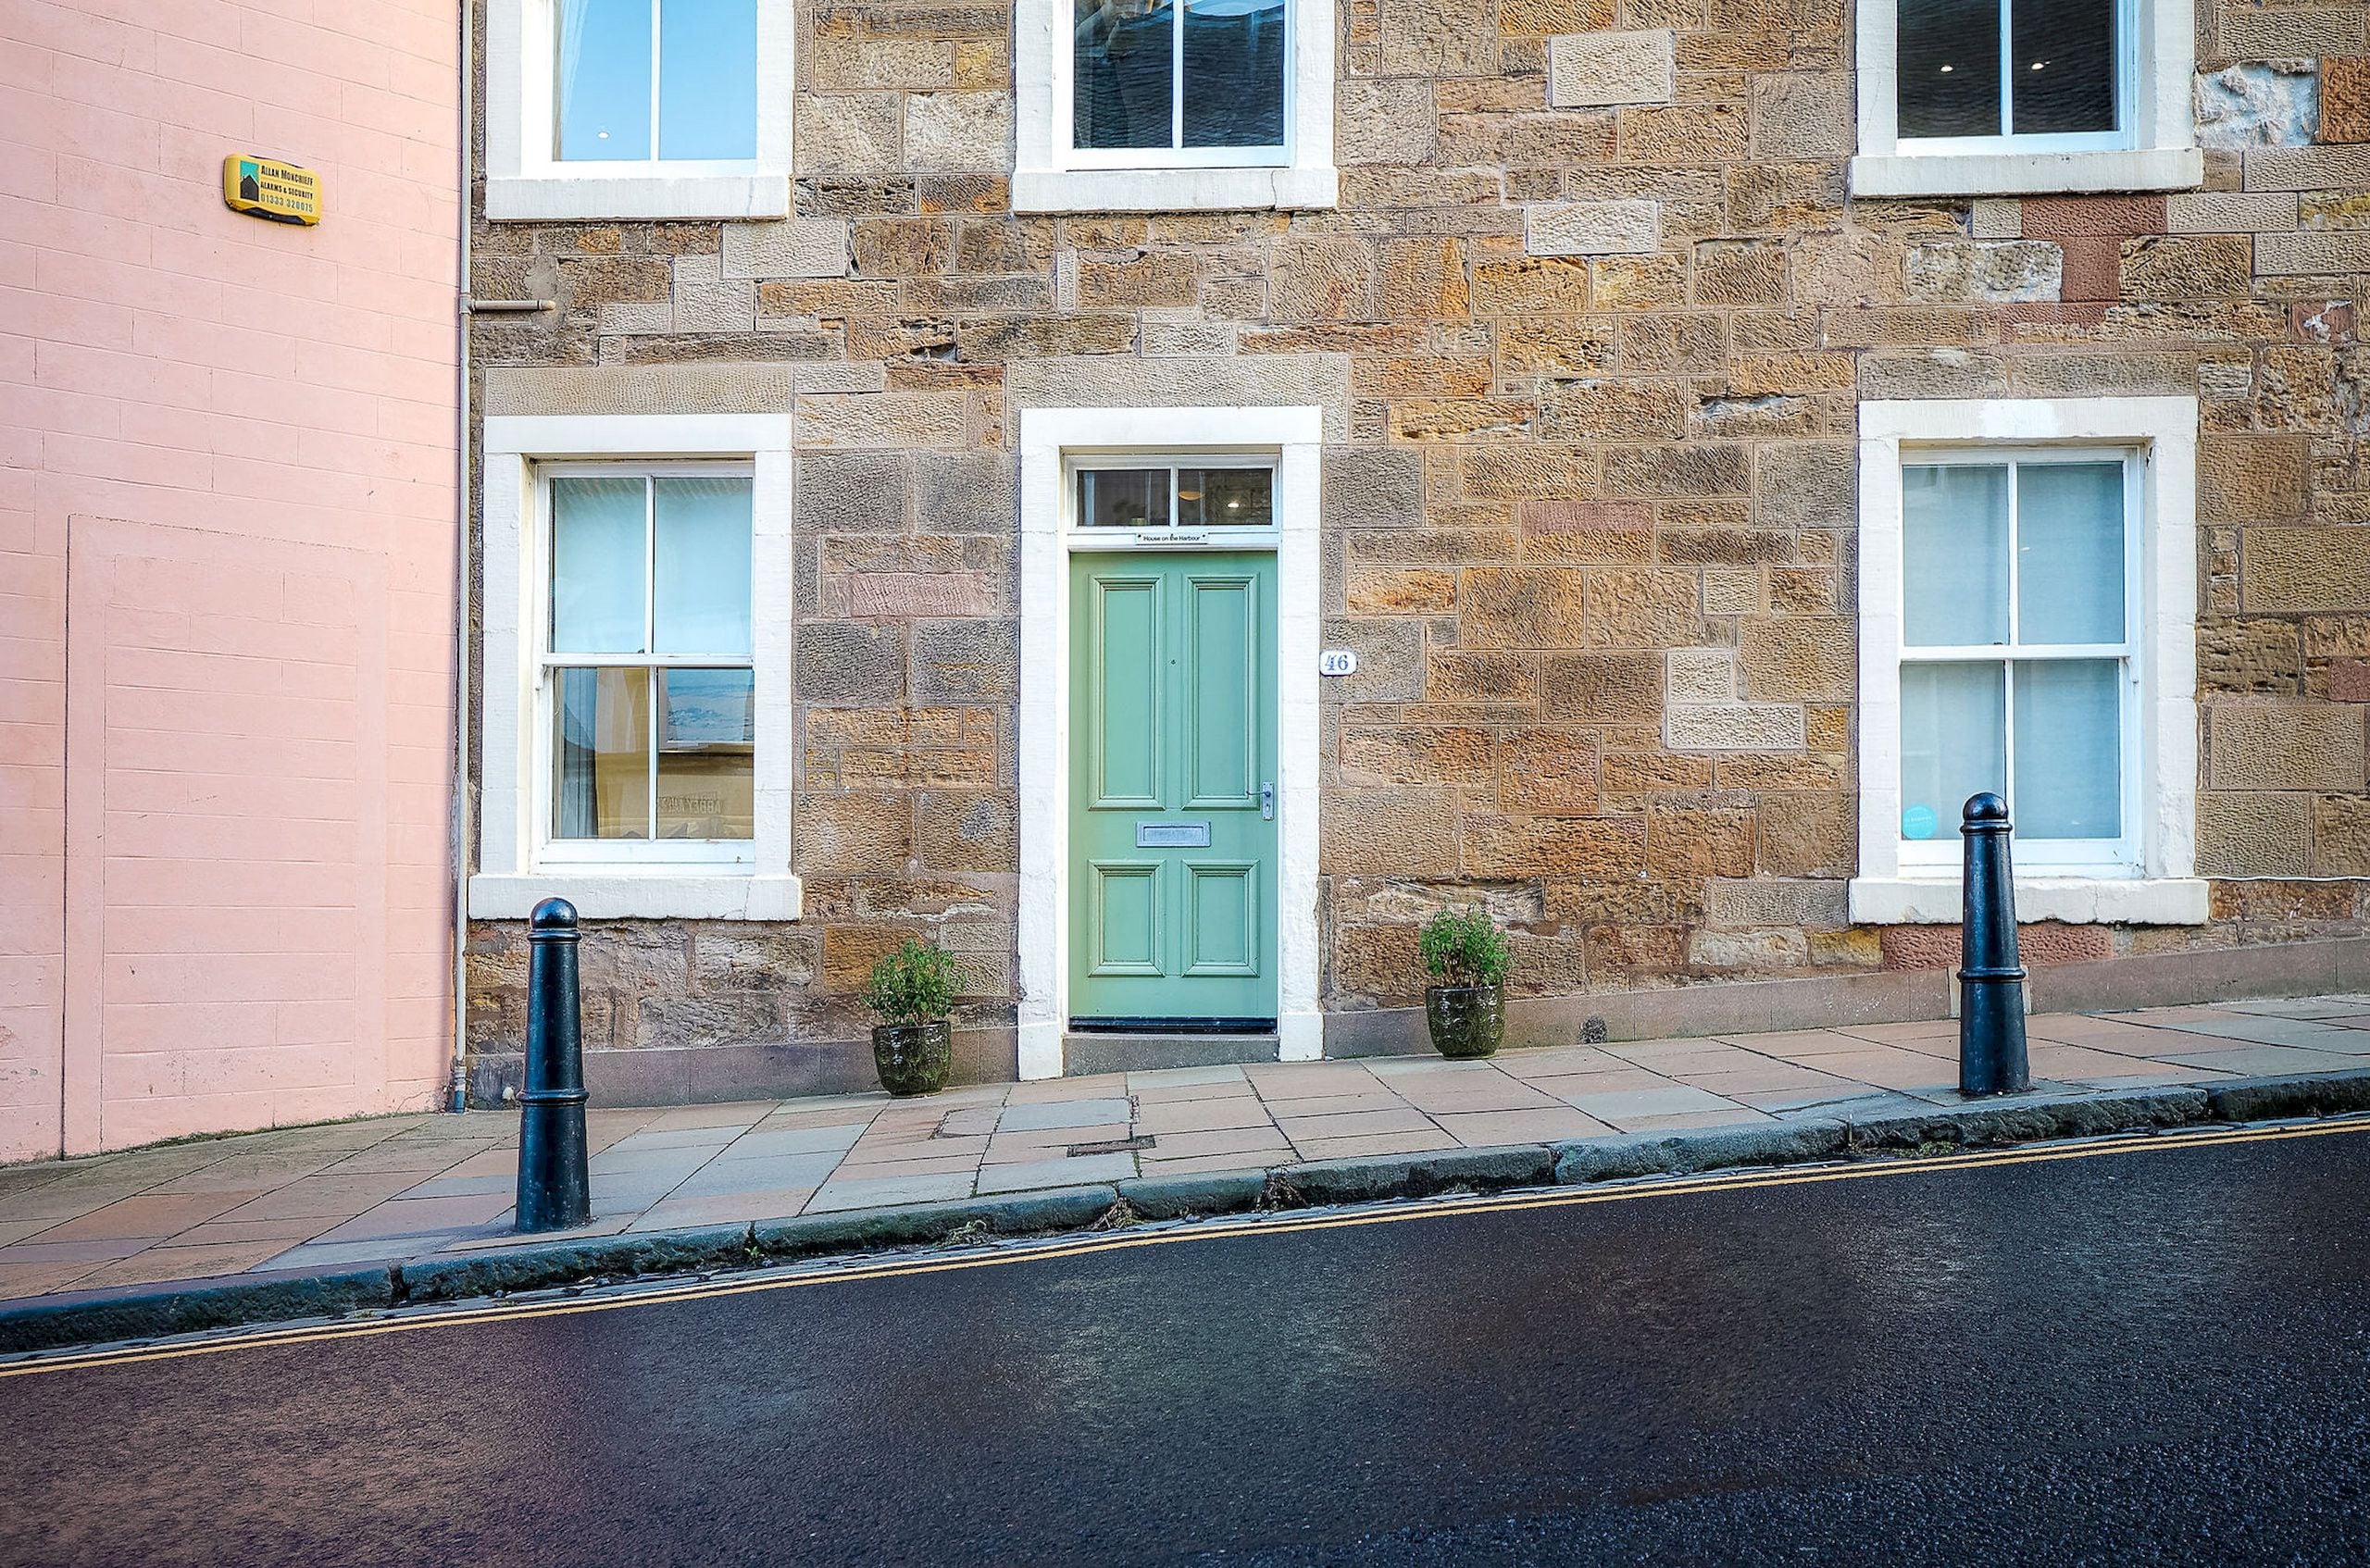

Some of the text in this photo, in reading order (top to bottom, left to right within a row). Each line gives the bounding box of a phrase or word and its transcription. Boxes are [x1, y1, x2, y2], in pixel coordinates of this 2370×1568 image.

[261, 165, 280, 178] ALLAN
[260, 181, 282, 193] ALARMS
[288, 188, 313, 200] SECURITY
[260, 193, 284, 205] 01333
[1325, 654, 1349, 671] 46
